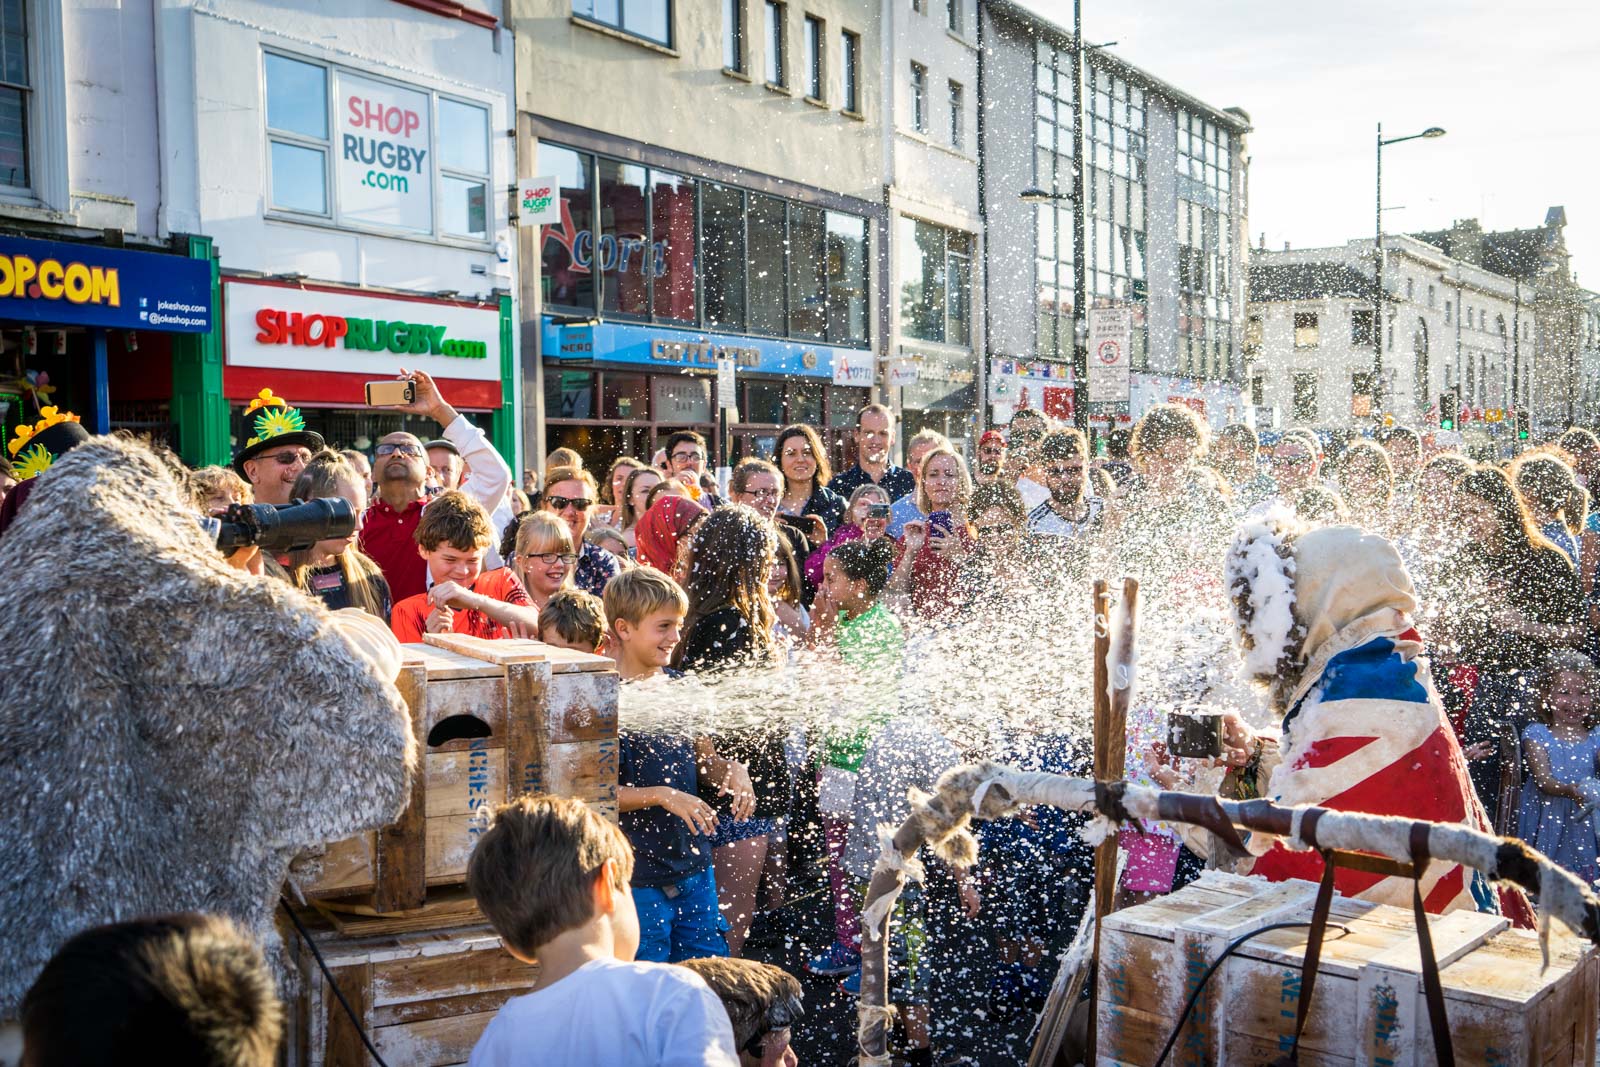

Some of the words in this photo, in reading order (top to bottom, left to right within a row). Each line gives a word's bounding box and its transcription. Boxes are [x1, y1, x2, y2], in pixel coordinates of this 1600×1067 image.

[348, 95, 420, 138] SHOP
[343, 133, 427, 175] RUGBY
[361, 170, 409, 194] .com
[525, 187, 551, 199] SHOP
[522, 197, 553, 209] RUGBY
[157, 300, 207, 314] jokeshop.com
[148, 312, 207, 327] @jokeshop.com
